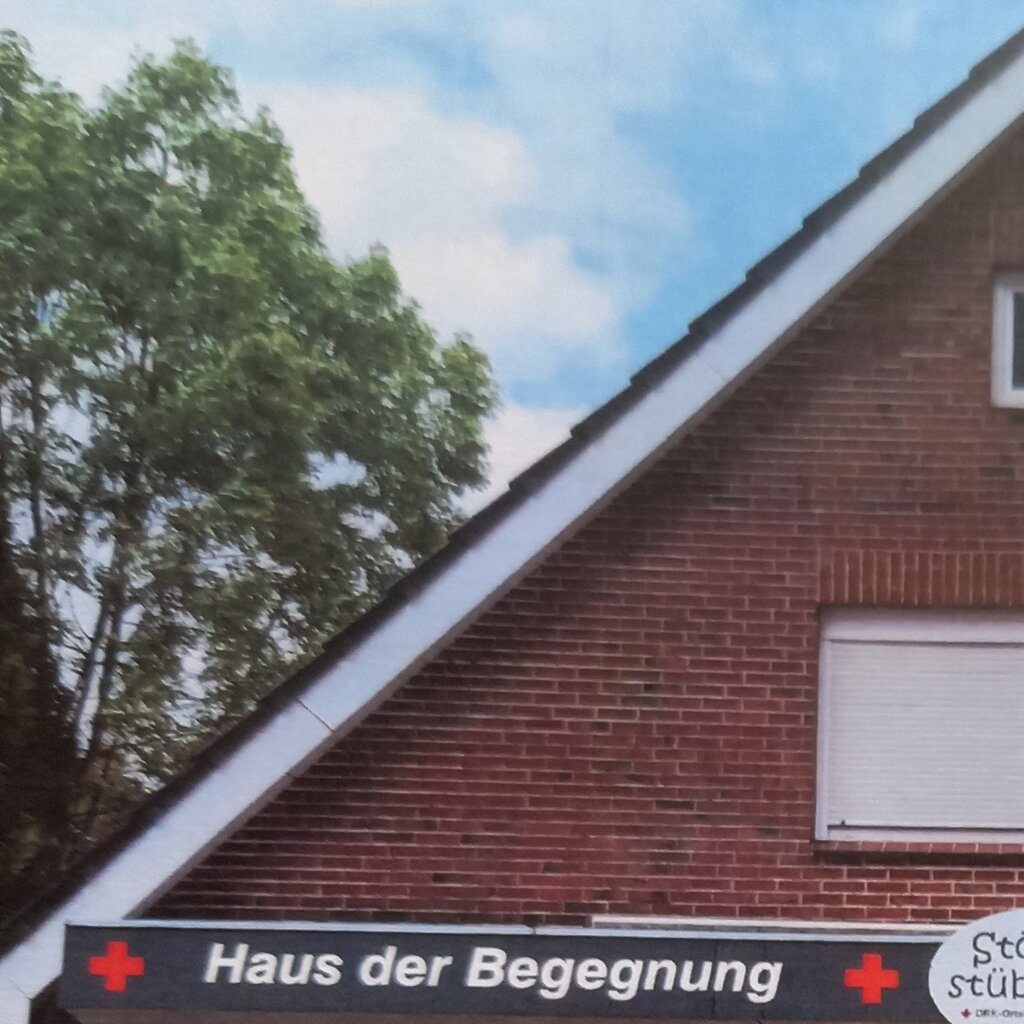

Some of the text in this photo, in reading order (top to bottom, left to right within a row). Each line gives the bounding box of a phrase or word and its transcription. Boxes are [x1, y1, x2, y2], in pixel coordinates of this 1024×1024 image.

[203, 942, 783, 1003] Haus der Begegnung
